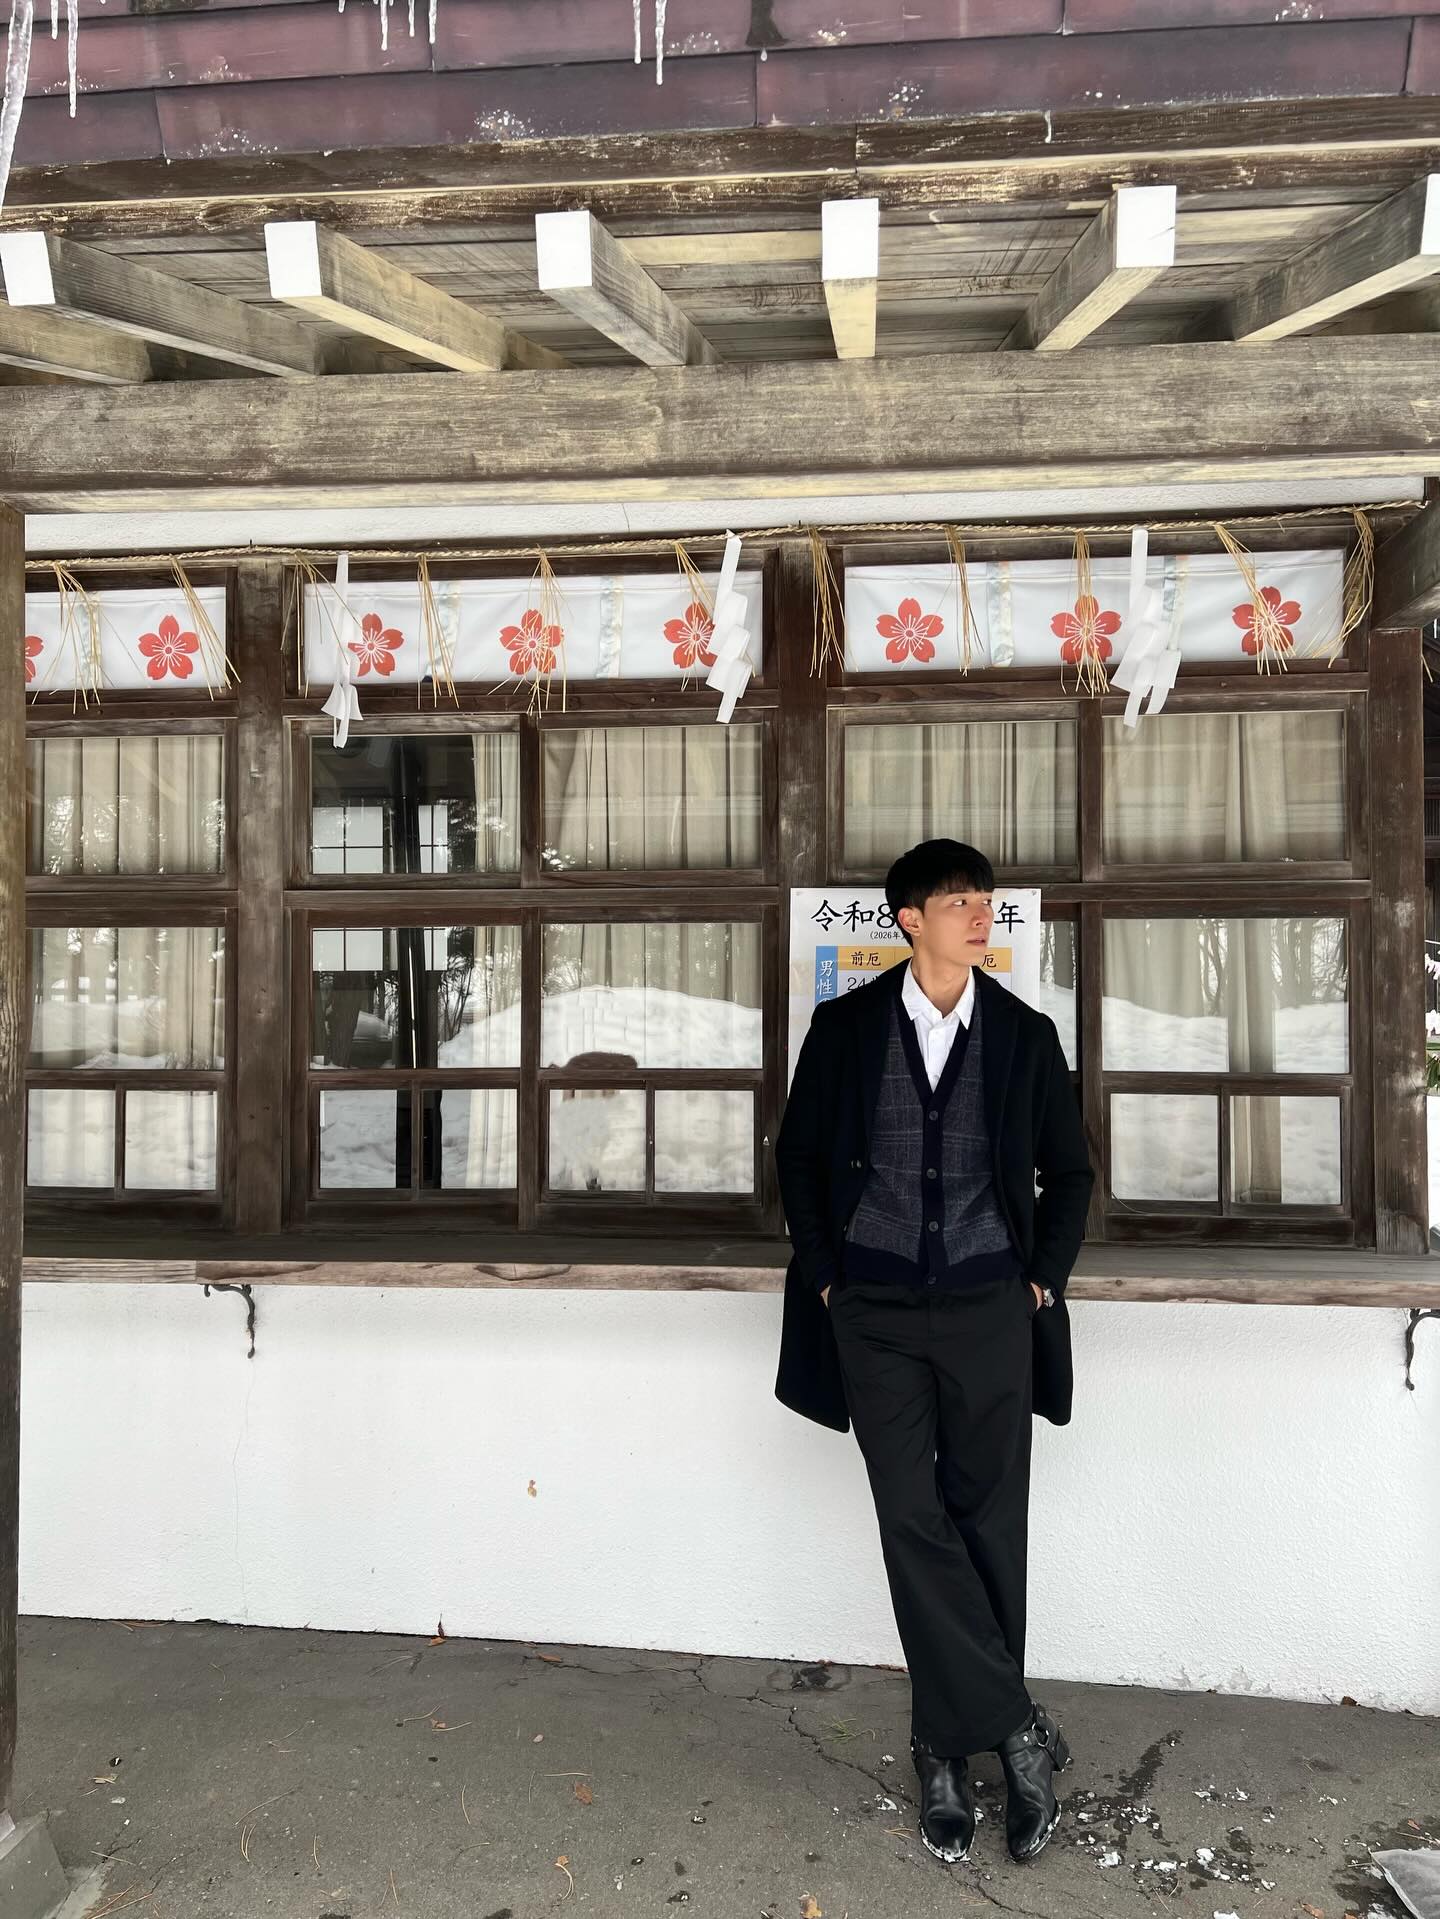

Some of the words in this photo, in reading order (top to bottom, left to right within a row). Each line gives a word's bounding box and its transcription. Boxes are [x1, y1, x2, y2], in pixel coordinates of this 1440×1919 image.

[811, 900, 896, 932] 令和8
[994, 902, 1025, 934] 年
[851, 951, 881, 966] 前厄
[816, 960, 834, 1002] 男性
